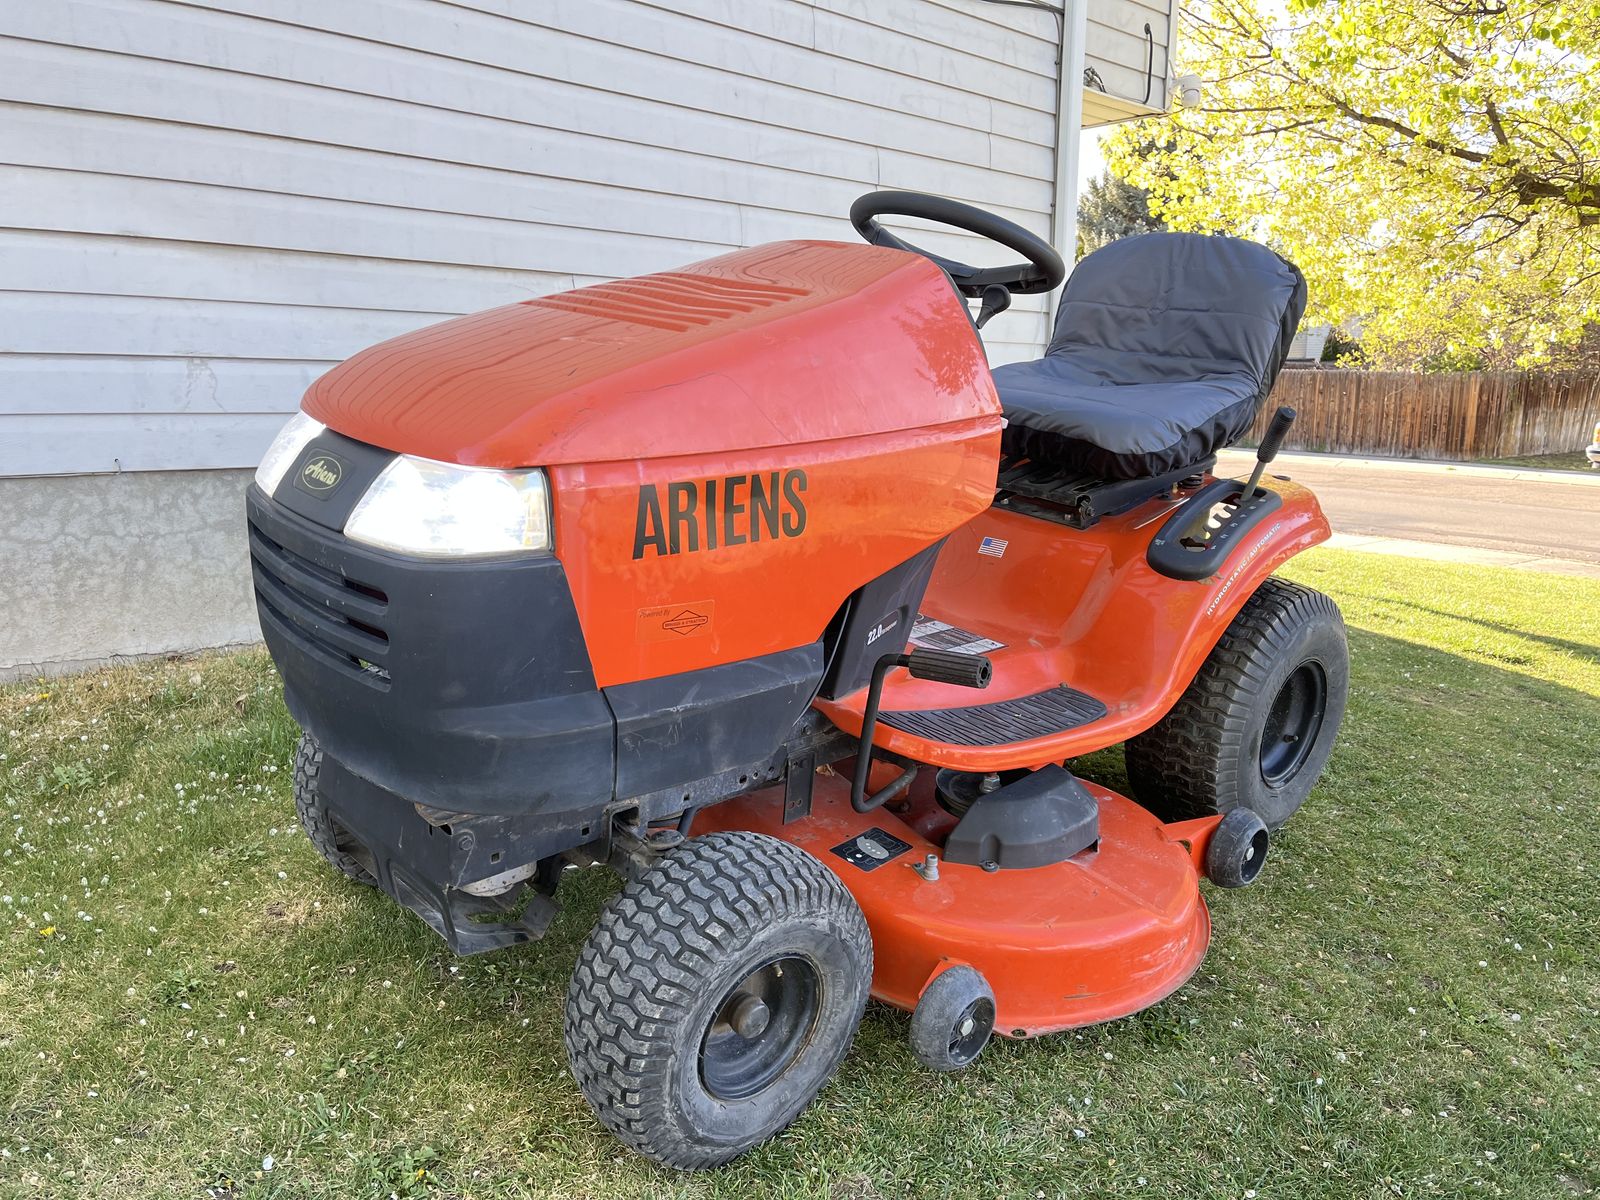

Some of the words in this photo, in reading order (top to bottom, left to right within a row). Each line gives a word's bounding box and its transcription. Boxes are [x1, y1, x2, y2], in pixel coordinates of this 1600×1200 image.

[304, 460, 337, 485] Ariens
[632, 468, 808, 560] ARIENS
[867, 624, 883, 646] 22.0
